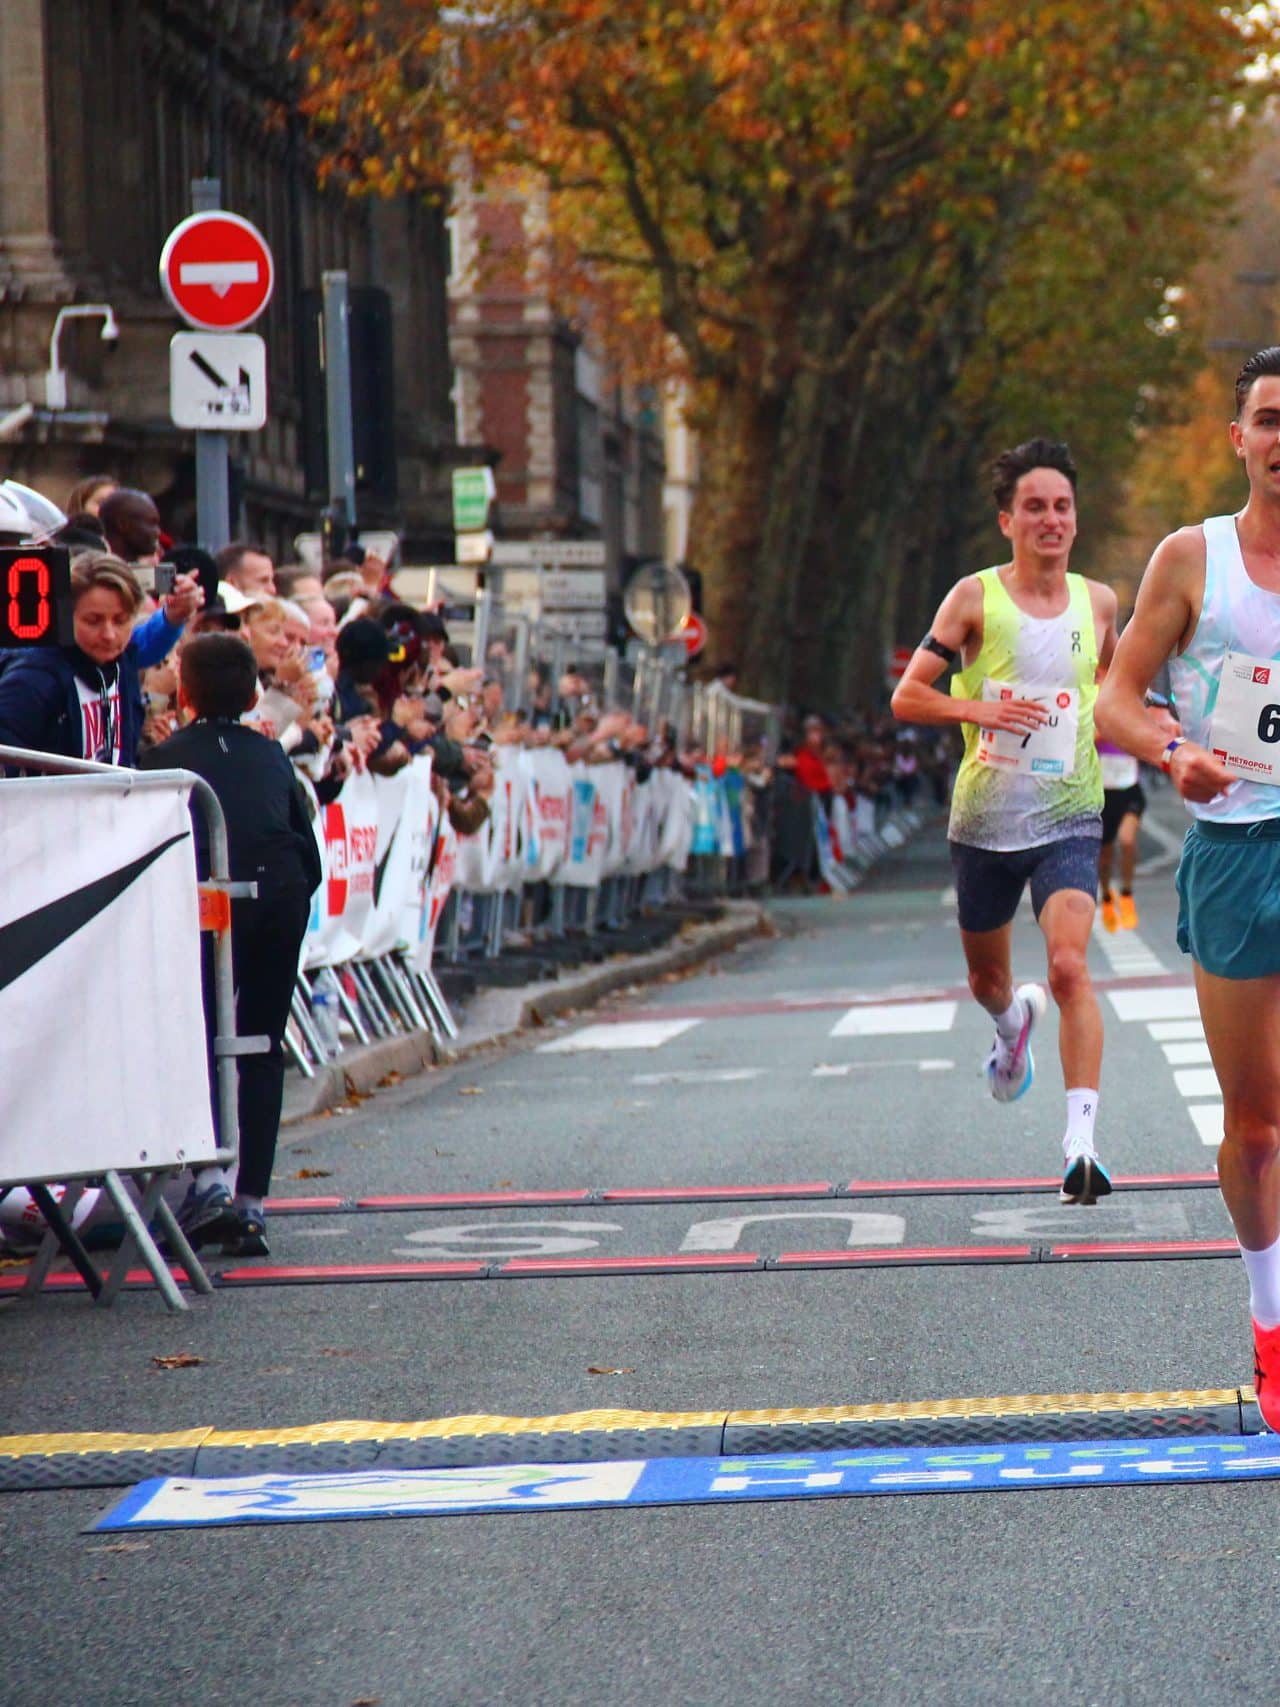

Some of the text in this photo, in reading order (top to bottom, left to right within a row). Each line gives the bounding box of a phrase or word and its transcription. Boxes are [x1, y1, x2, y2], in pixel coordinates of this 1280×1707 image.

[8, 558, 49, 639] 0
[1228, 756, 1273, 771] MÉTROPOLE
[715, 1442, 1247, 1472] Région
